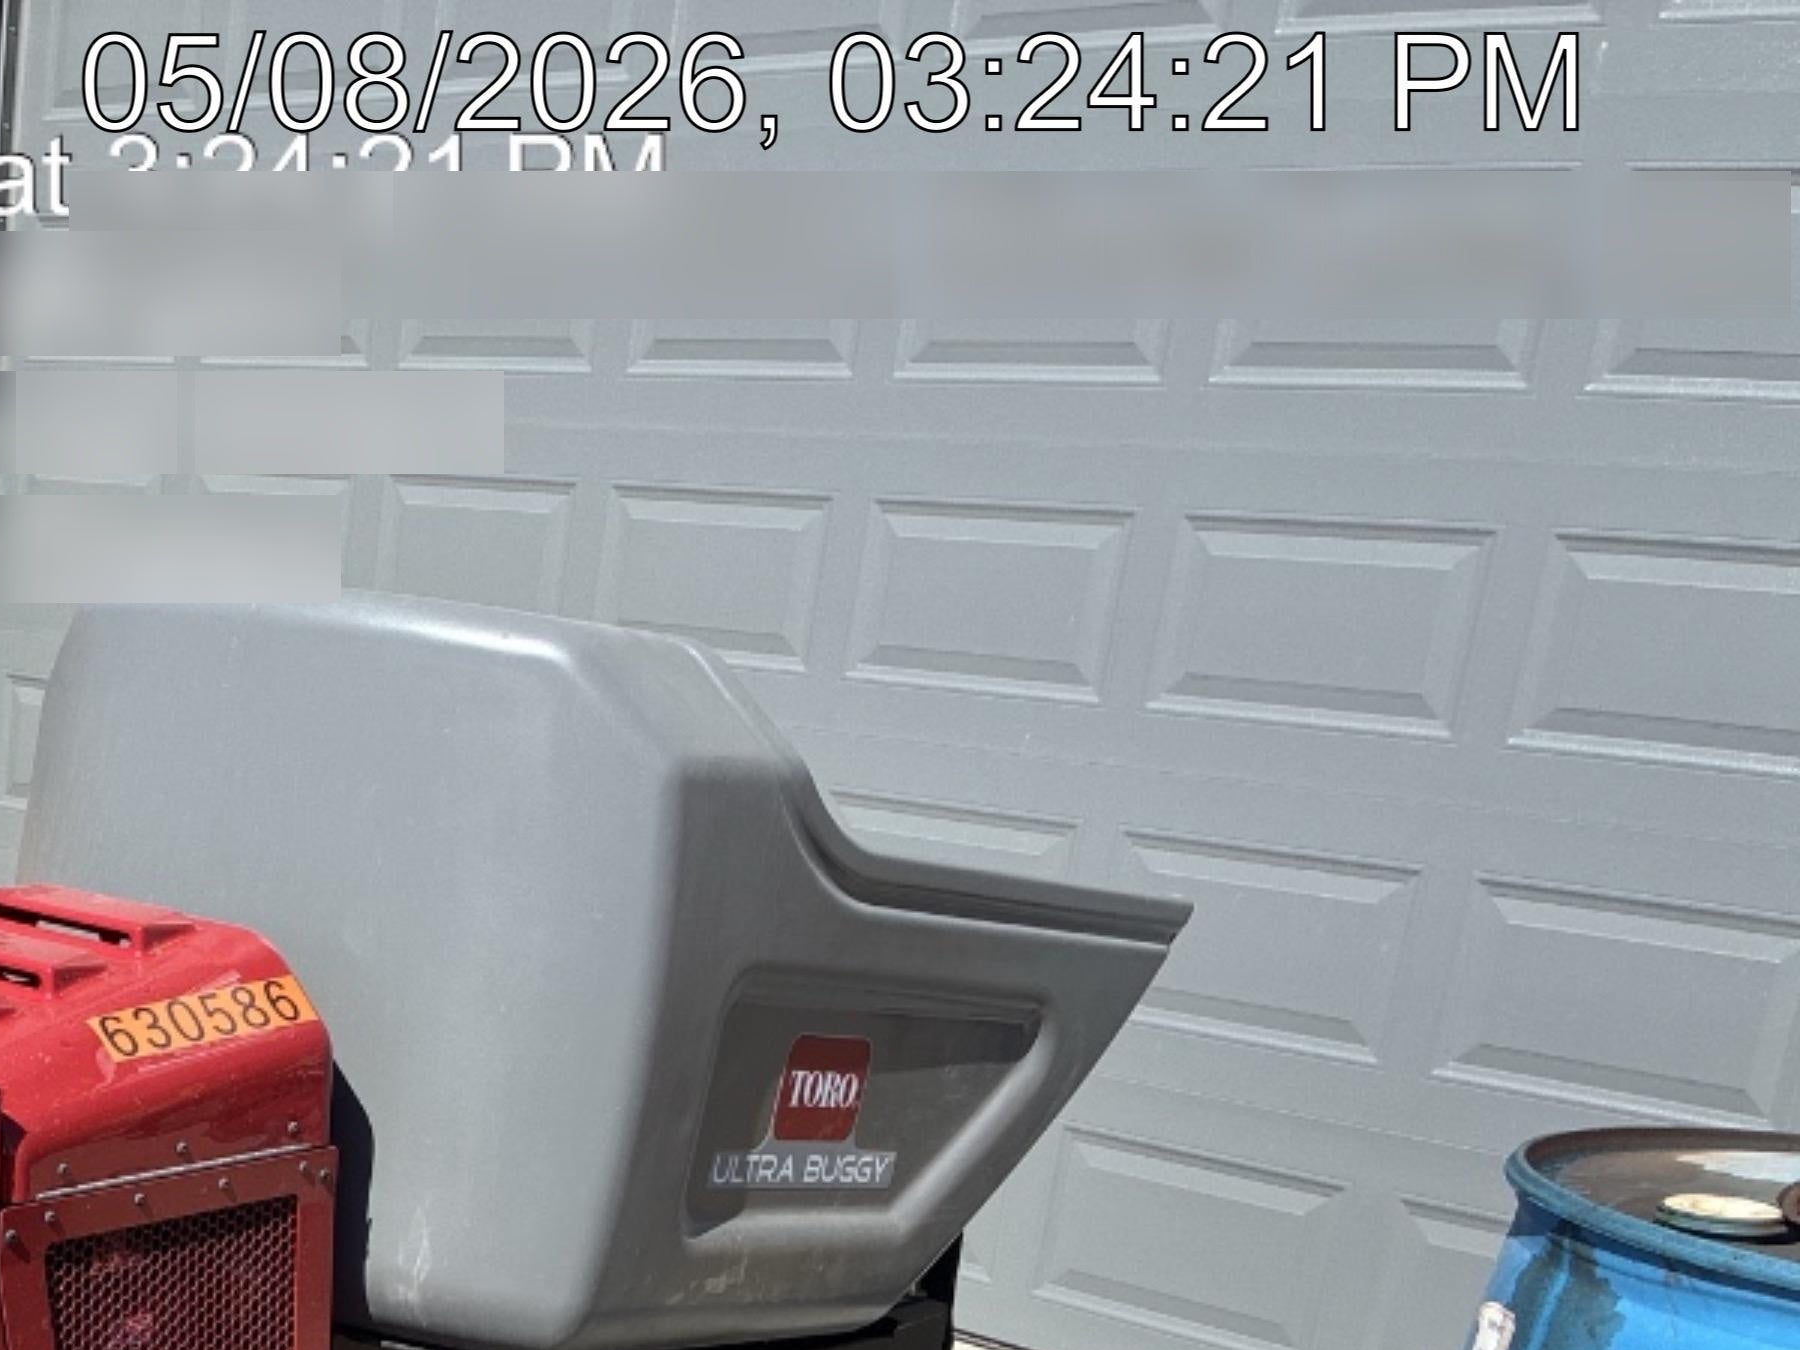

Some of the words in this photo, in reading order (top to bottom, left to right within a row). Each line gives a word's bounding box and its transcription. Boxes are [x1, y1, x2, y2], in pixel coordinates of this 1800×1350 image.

[98, 980, 299, 1057] 630586
[788, 1069, 859, 1108] TORO
[712, 1153, 795, 1184] ULTRA
[802, 1153, 890, 1184] BUGGY
